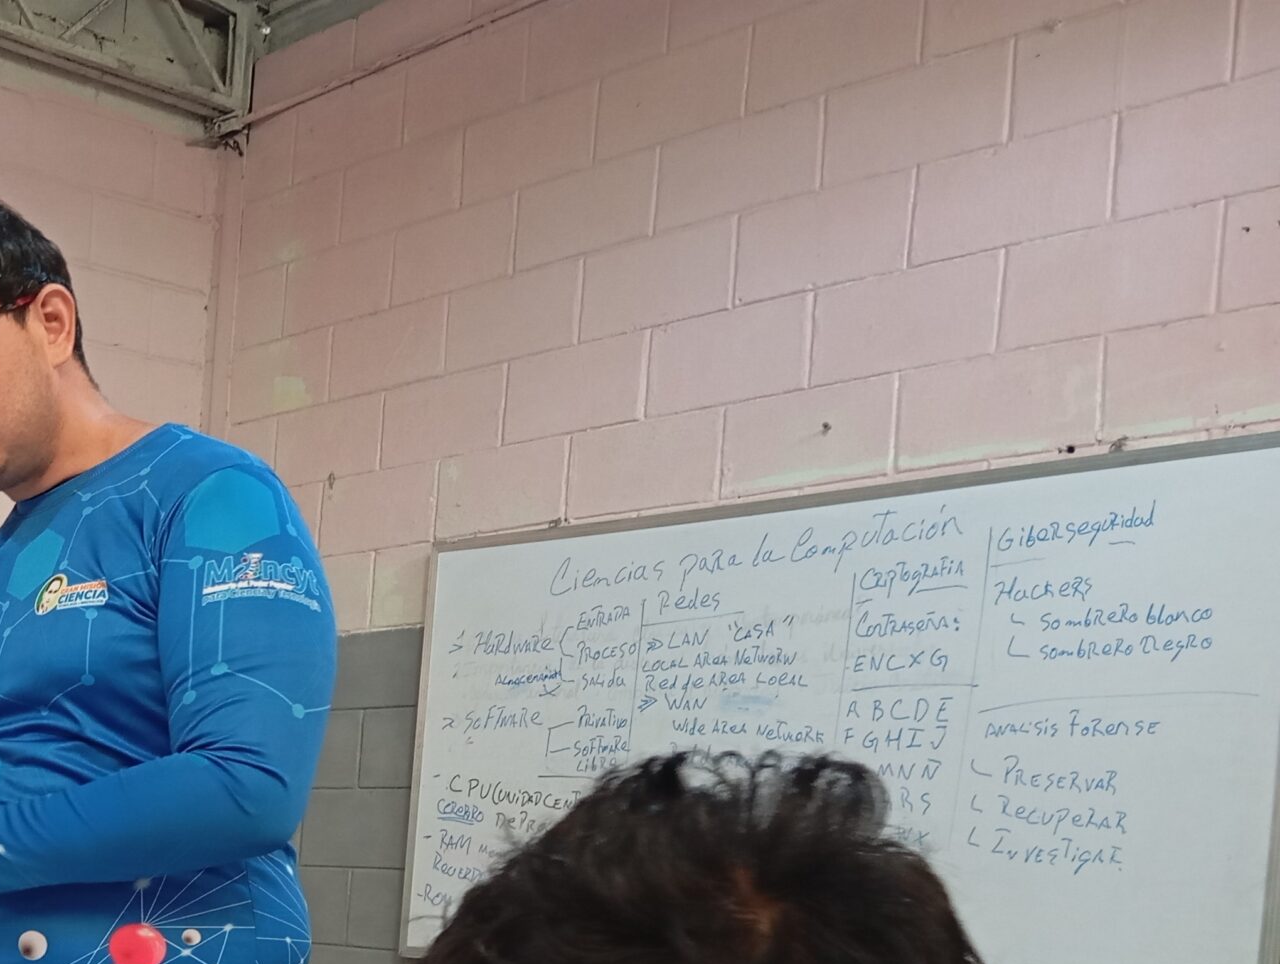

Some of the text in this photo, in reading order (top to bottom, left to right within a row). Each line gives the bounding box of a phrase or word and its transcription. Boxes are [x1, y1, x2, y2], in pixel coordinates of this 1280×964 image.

[752, 532, 785, 568] la
[58, 589, 107, 604] CIENCIA
[667, 628, 710, 649] LAN
[664, 693, 708, 711] WAN
[440, 829, 472, 855] RAM
